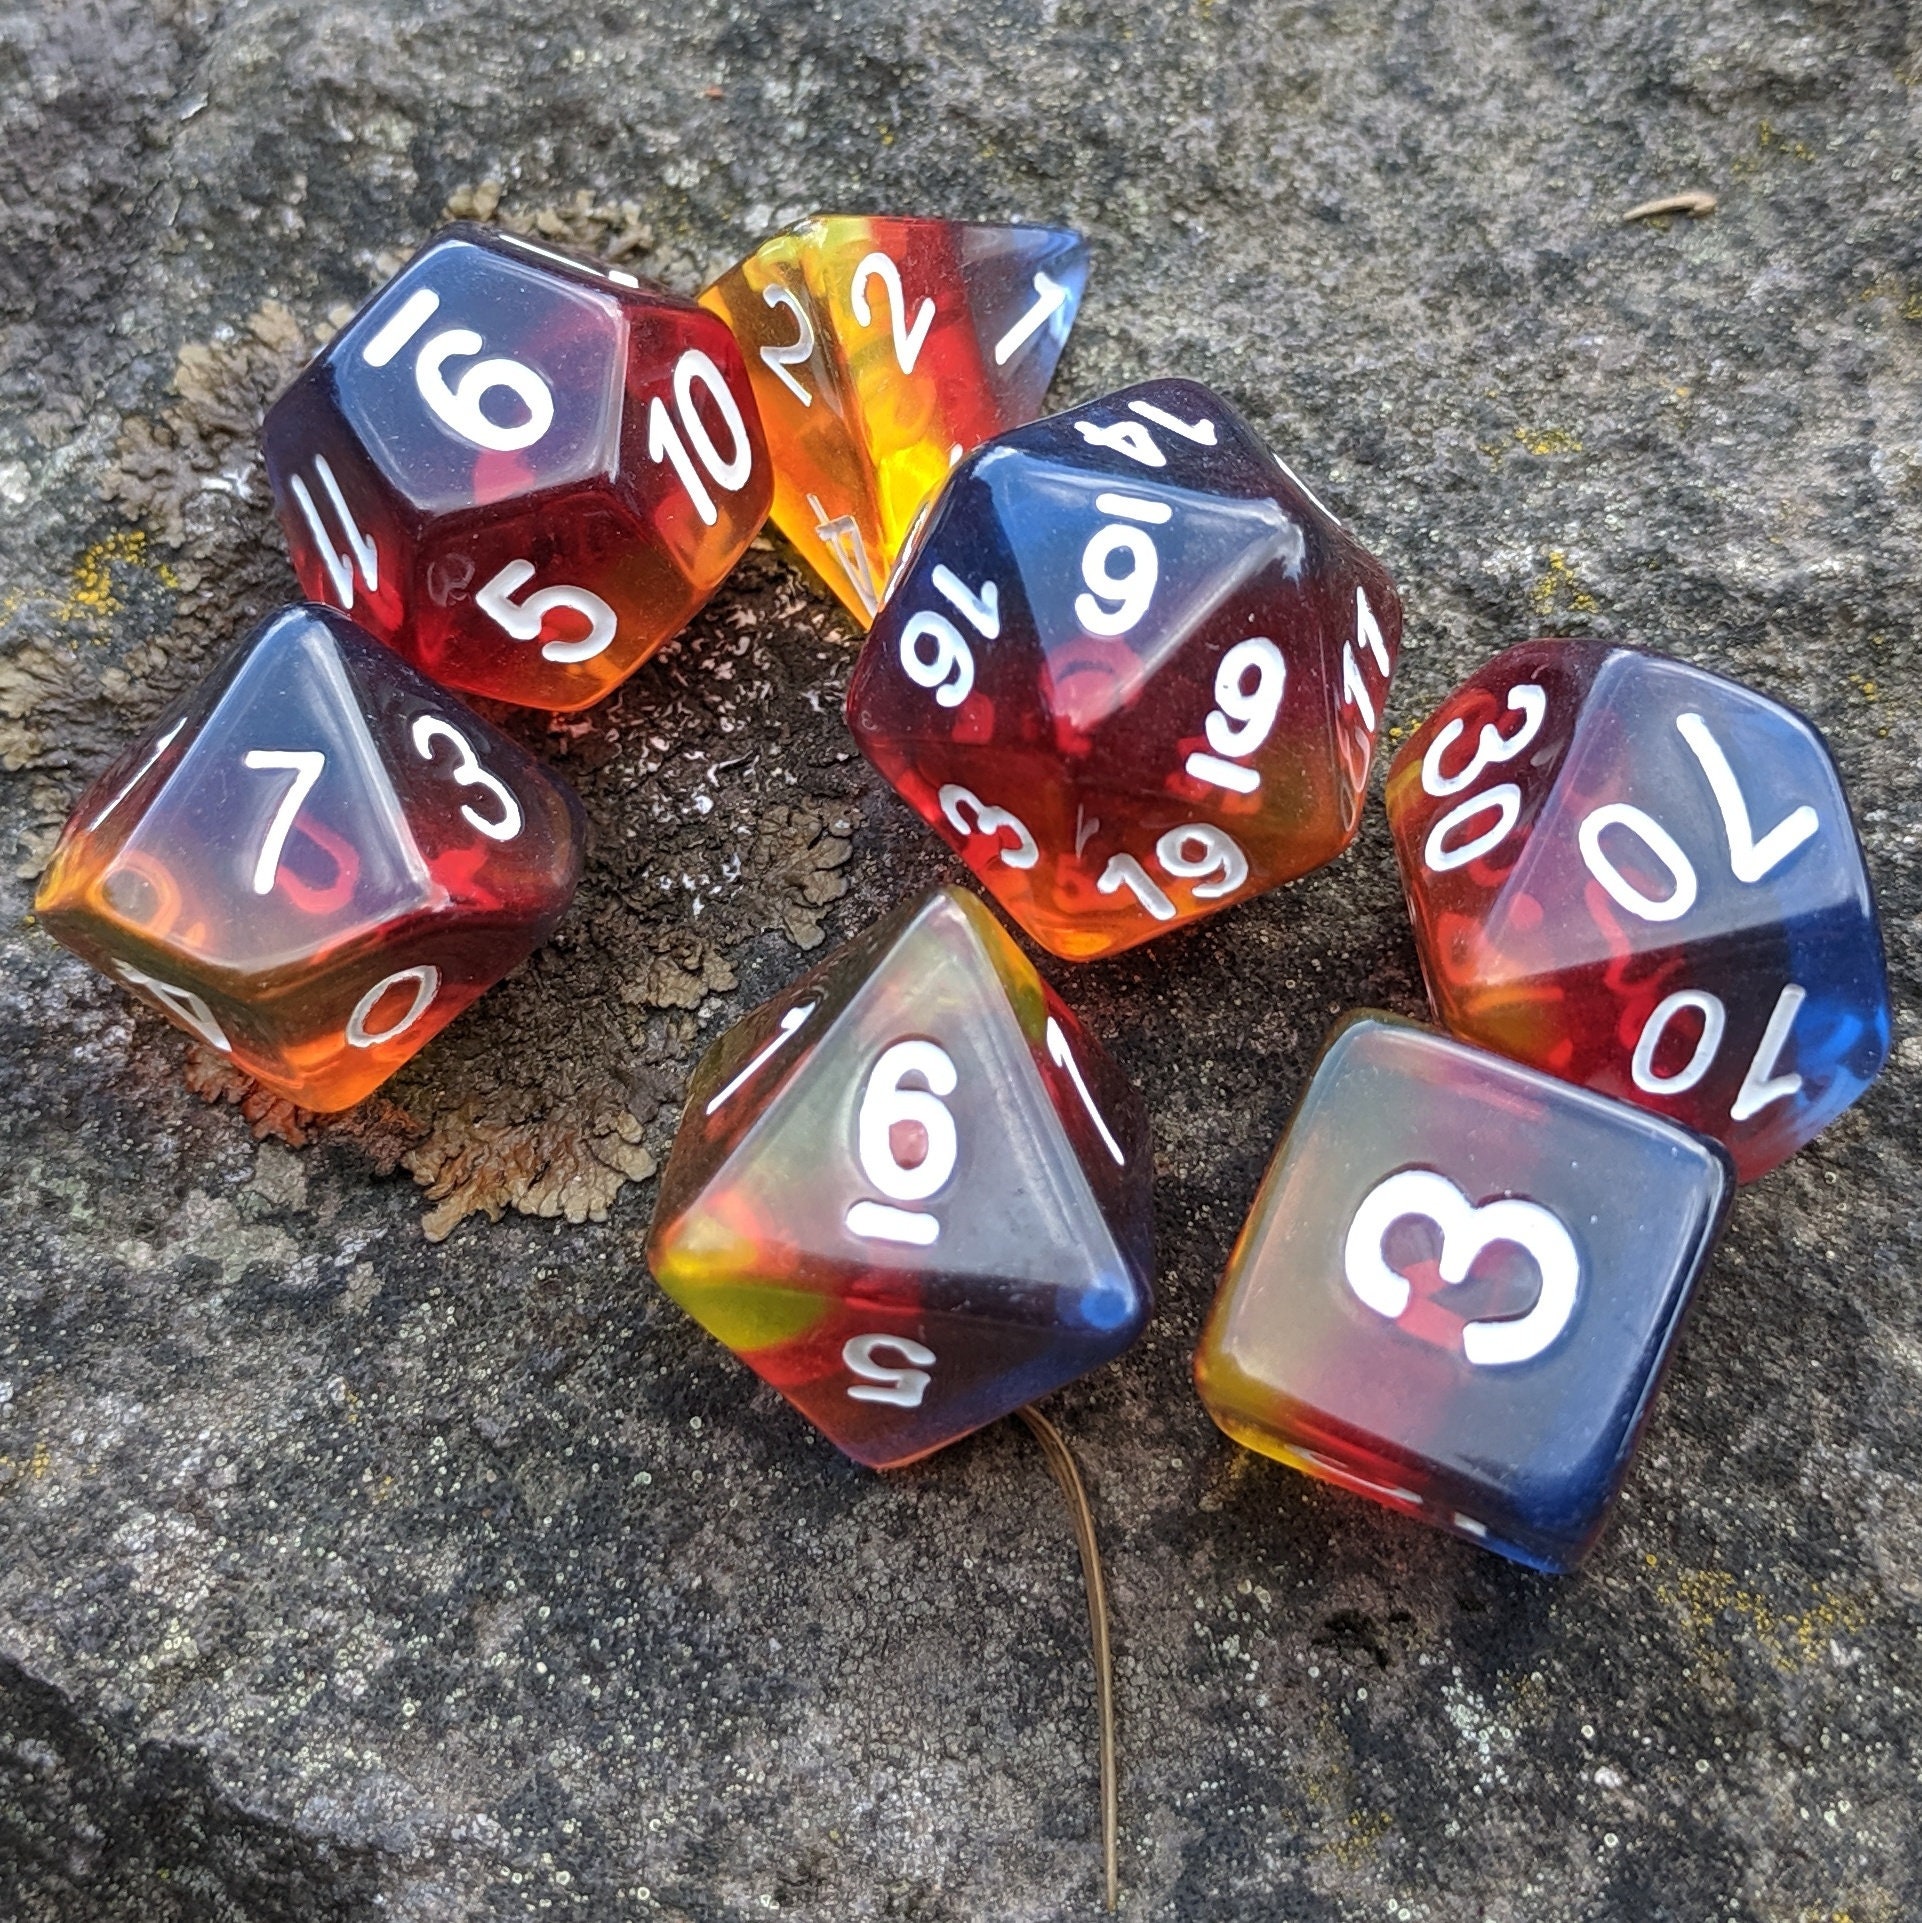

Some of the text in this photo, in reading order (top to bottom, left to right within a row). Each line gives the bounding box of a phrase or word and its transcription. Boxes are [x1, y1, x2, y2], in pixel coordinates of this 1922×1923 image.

[849, 251, 936, 376] 2
[994, 271, 1072, 366] 1
[648, 349, 752, 526] 10
[1073, 400, 1218, 468] 14
[290, 454, 378, 610] 11
[474, 559, 618, 664] 5
[899, 563, 1000, 708] 16
[244, 749, 326, 895] 7
[411, 714, 523, 841] 3
[938, 783, 1039, 869] 3
[1420, 684, 1547, 873] 30
[1578, 712, 1820, 922] 70
[1096, 822, 1249, 921] 19
[345, 964, 441, 1049] 0
[1630, 983, 1806, 1121] 10
[1344, 1169, 1580, 1365] 3
[842, 1332, 937, 1408] 5
